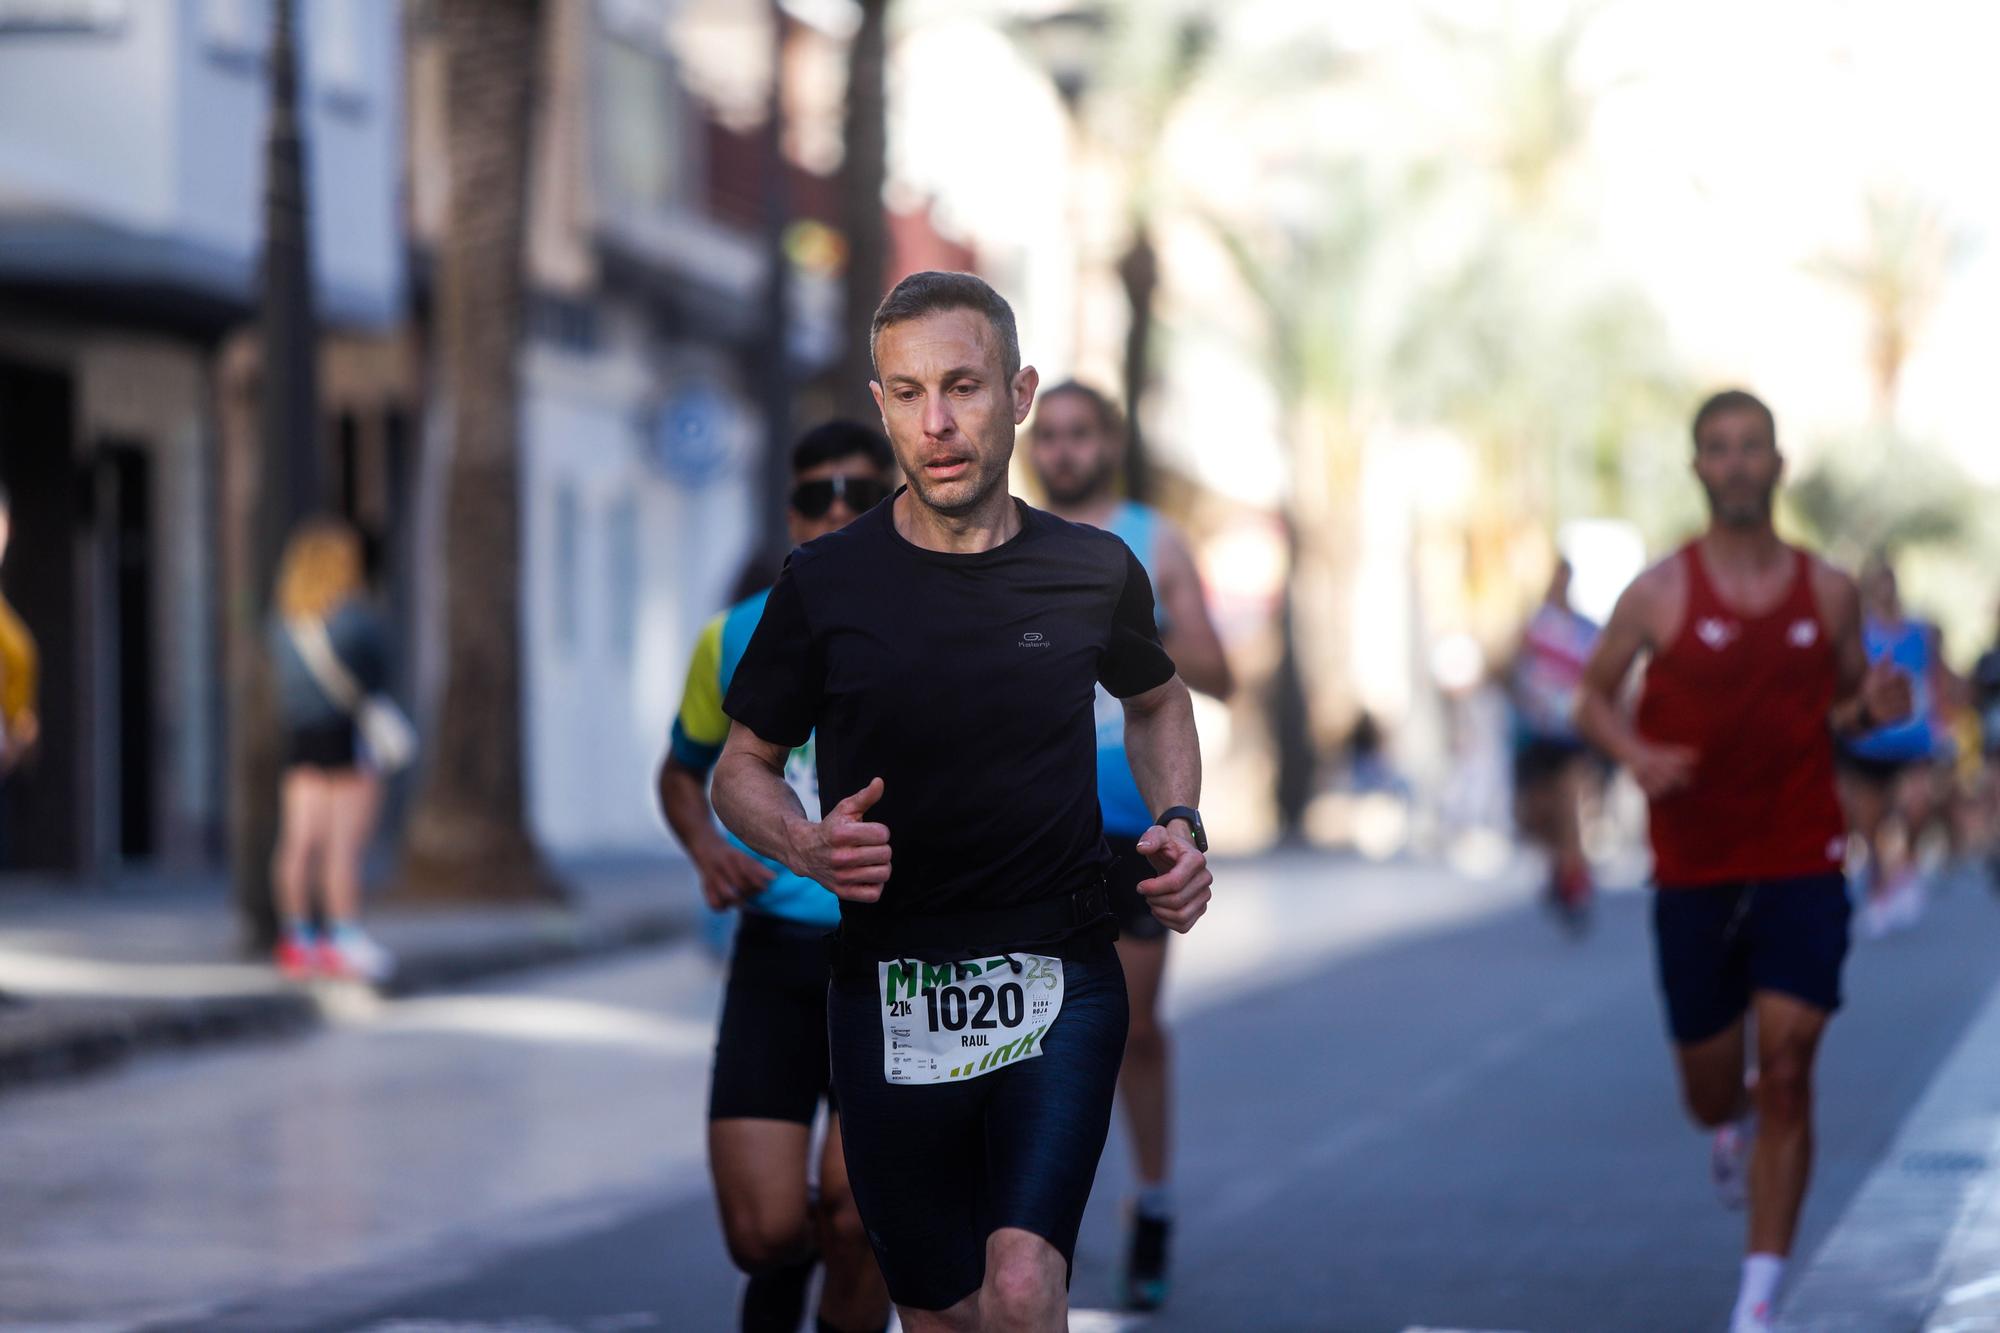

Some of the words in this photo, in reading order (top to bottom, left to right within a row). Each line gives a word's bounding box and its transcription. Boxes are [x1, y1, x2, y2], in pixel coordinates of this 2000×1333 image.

[890, 1000, 912, 1017] 21k
[921, 982, 1024, 1032] 1020
[961, 1034, 990, 1048] RAUL
